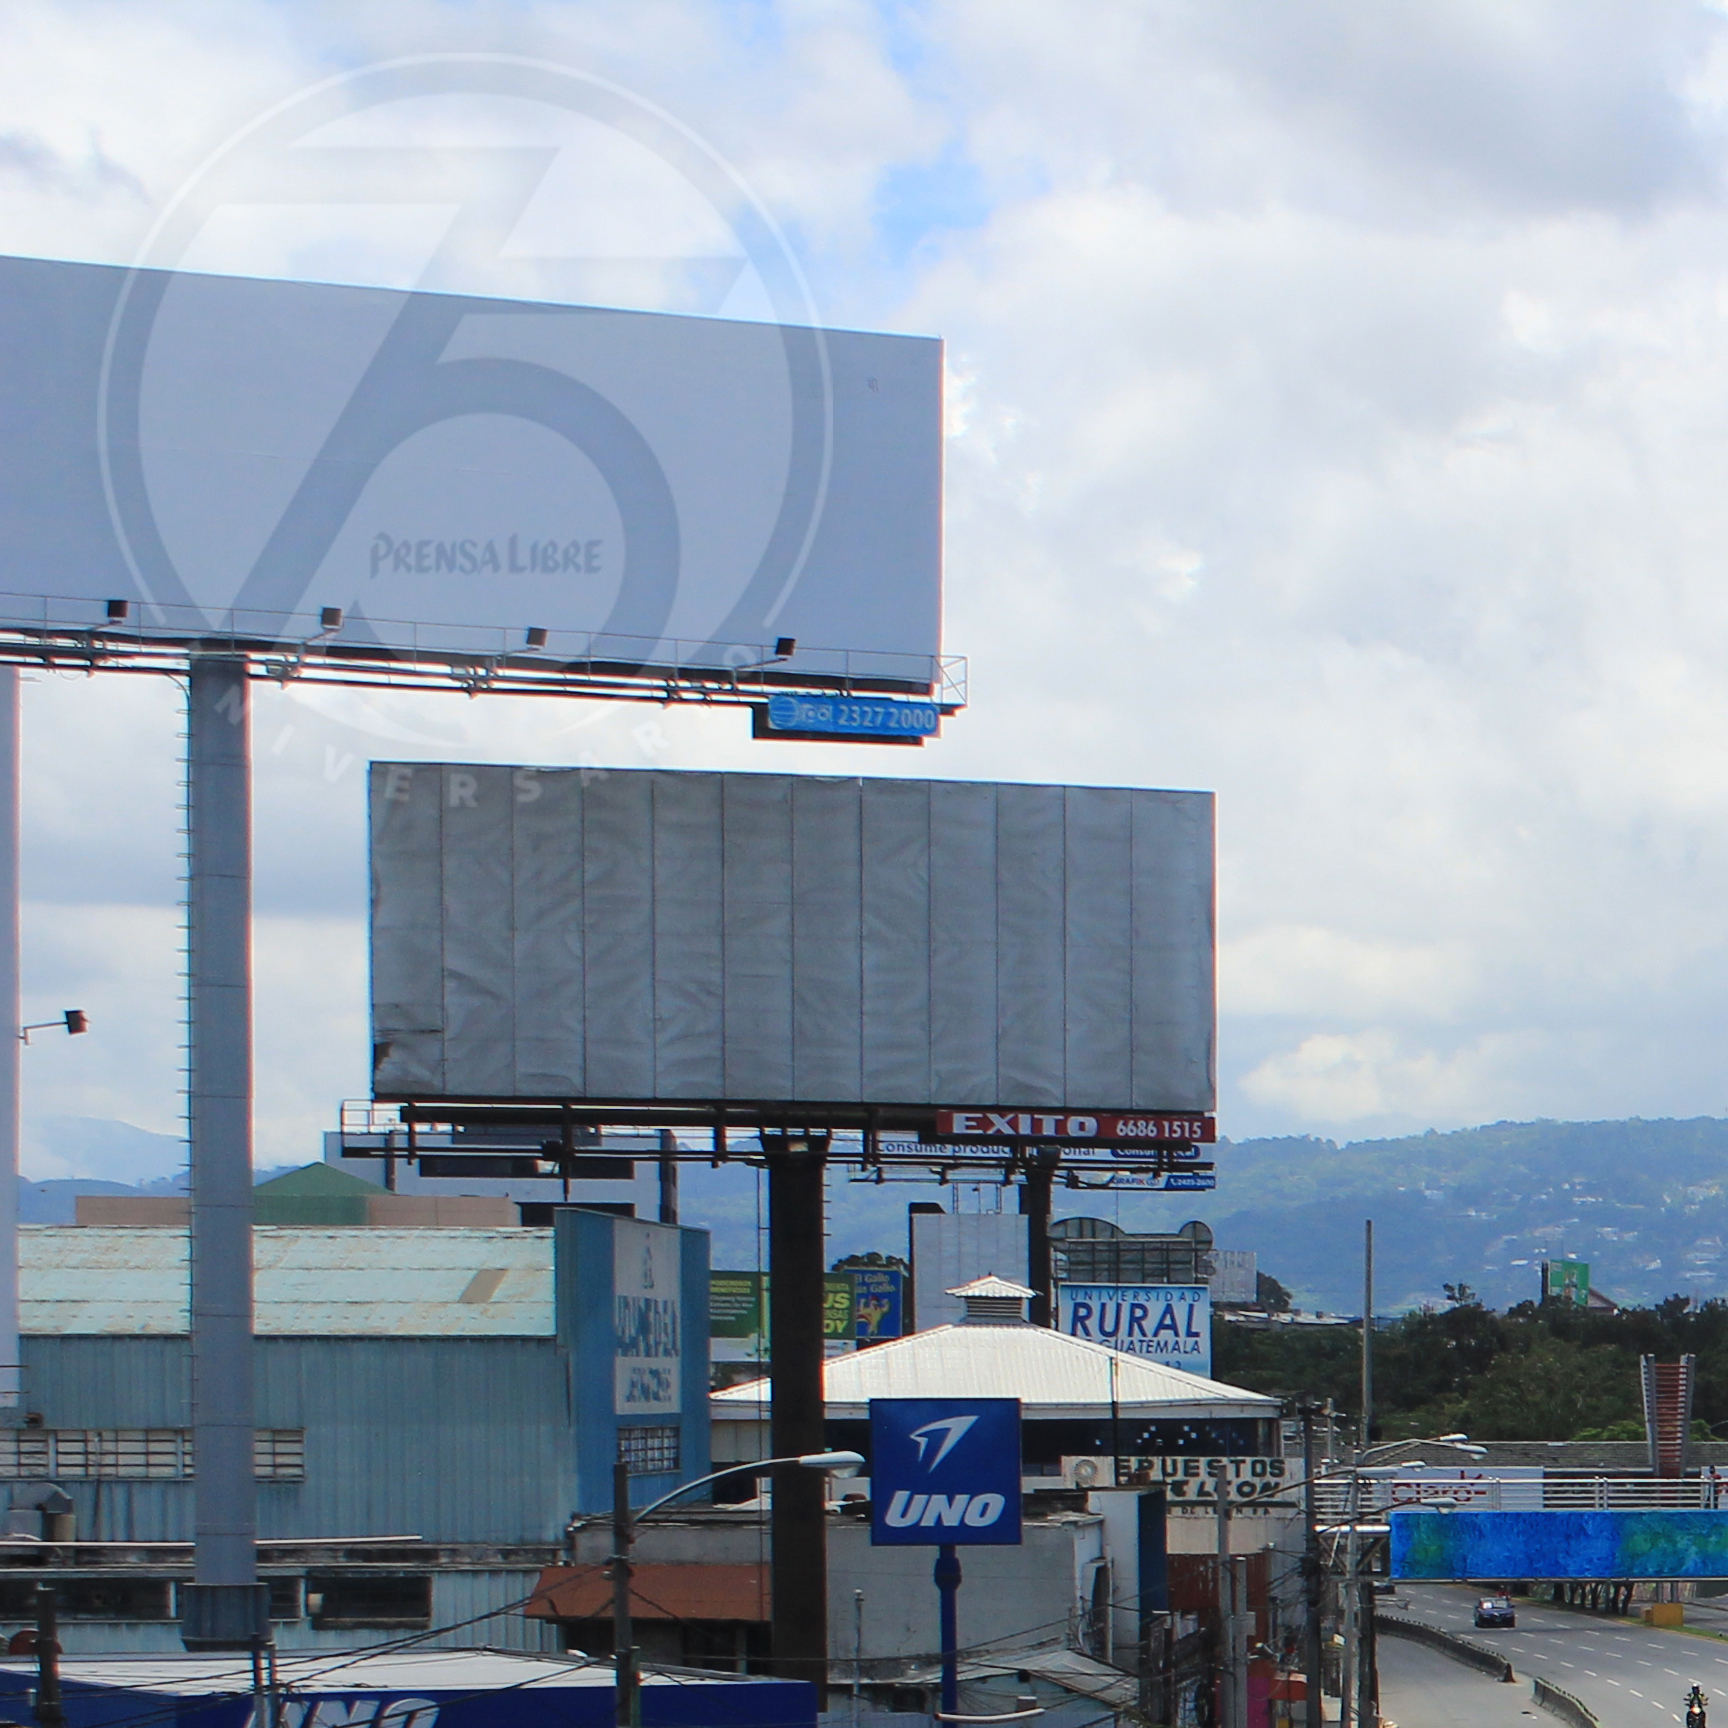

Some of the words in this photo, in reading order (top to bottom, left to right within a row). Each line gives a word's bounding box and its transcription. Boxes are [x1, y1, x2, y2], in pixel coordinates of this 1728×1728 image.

[837, 705, 885, 727] 2327
[888, 708, 936, 729] 2000
[953, 1114, 1098, 1137] EXITO
[1116, 1120, 1157, 1137] 6686
[1163, 1121, 1201, 1138] 1515
[1070, 1290, 1201, 1302] UNIVERSIDAD
[1070, 1302, 1202, 1338] RURAL
[1117, 1458, 1286, 1478] EPUESTOS
[885, 1490, 1006, 1528] UNO
